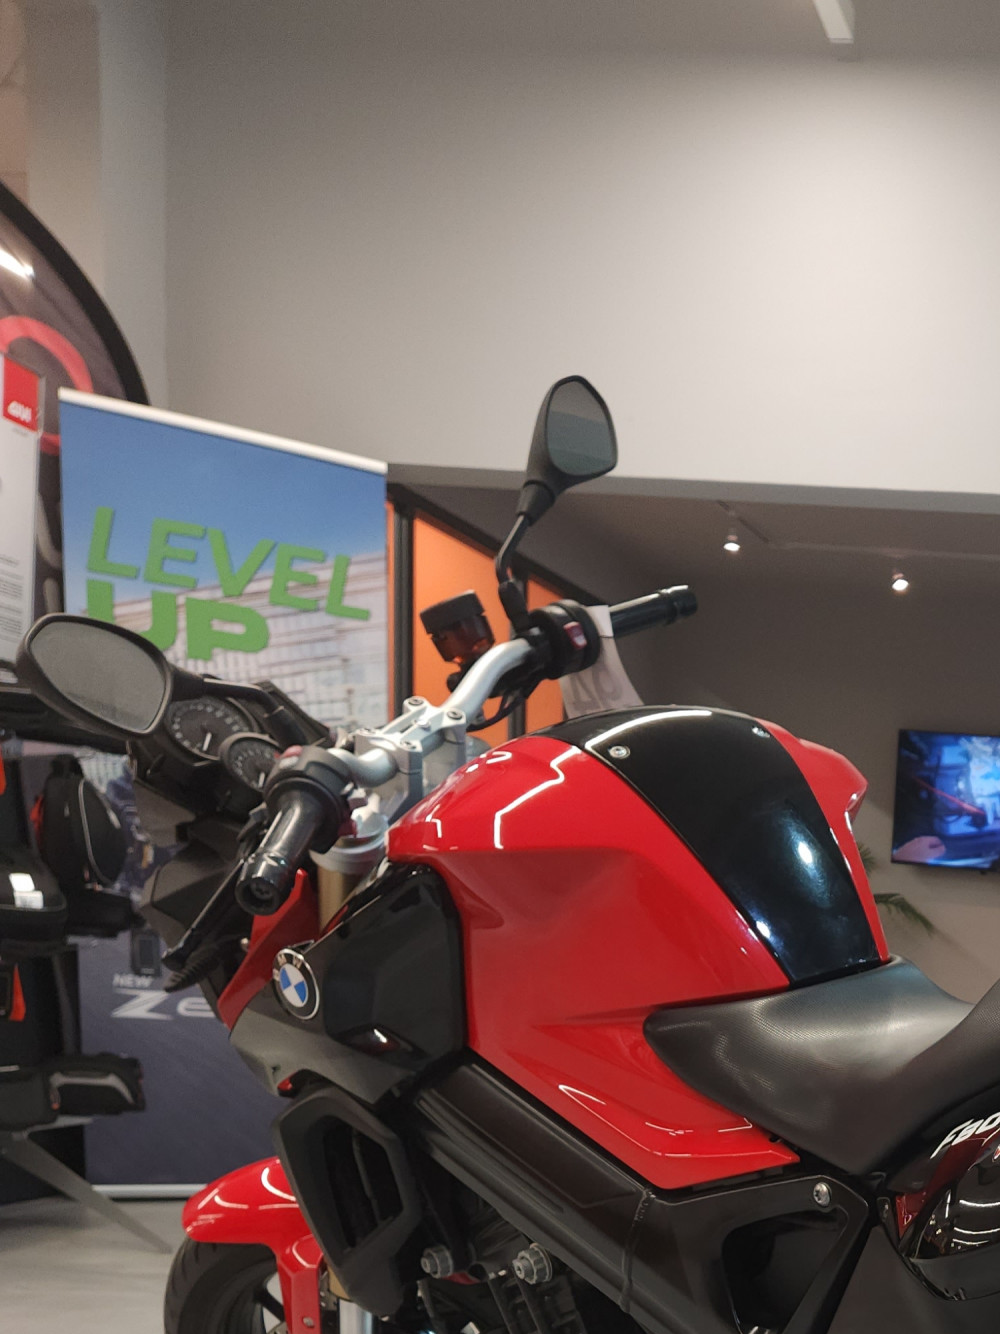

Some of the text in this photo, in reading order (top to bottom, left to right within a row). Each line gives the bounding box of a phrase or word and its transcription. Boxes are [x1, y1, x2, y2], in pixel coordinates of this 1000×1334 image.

[86, 506, 370, 621] LEVEL
[86, 579, 270, 661] UP
[112, 972, 154, 988] NEW
